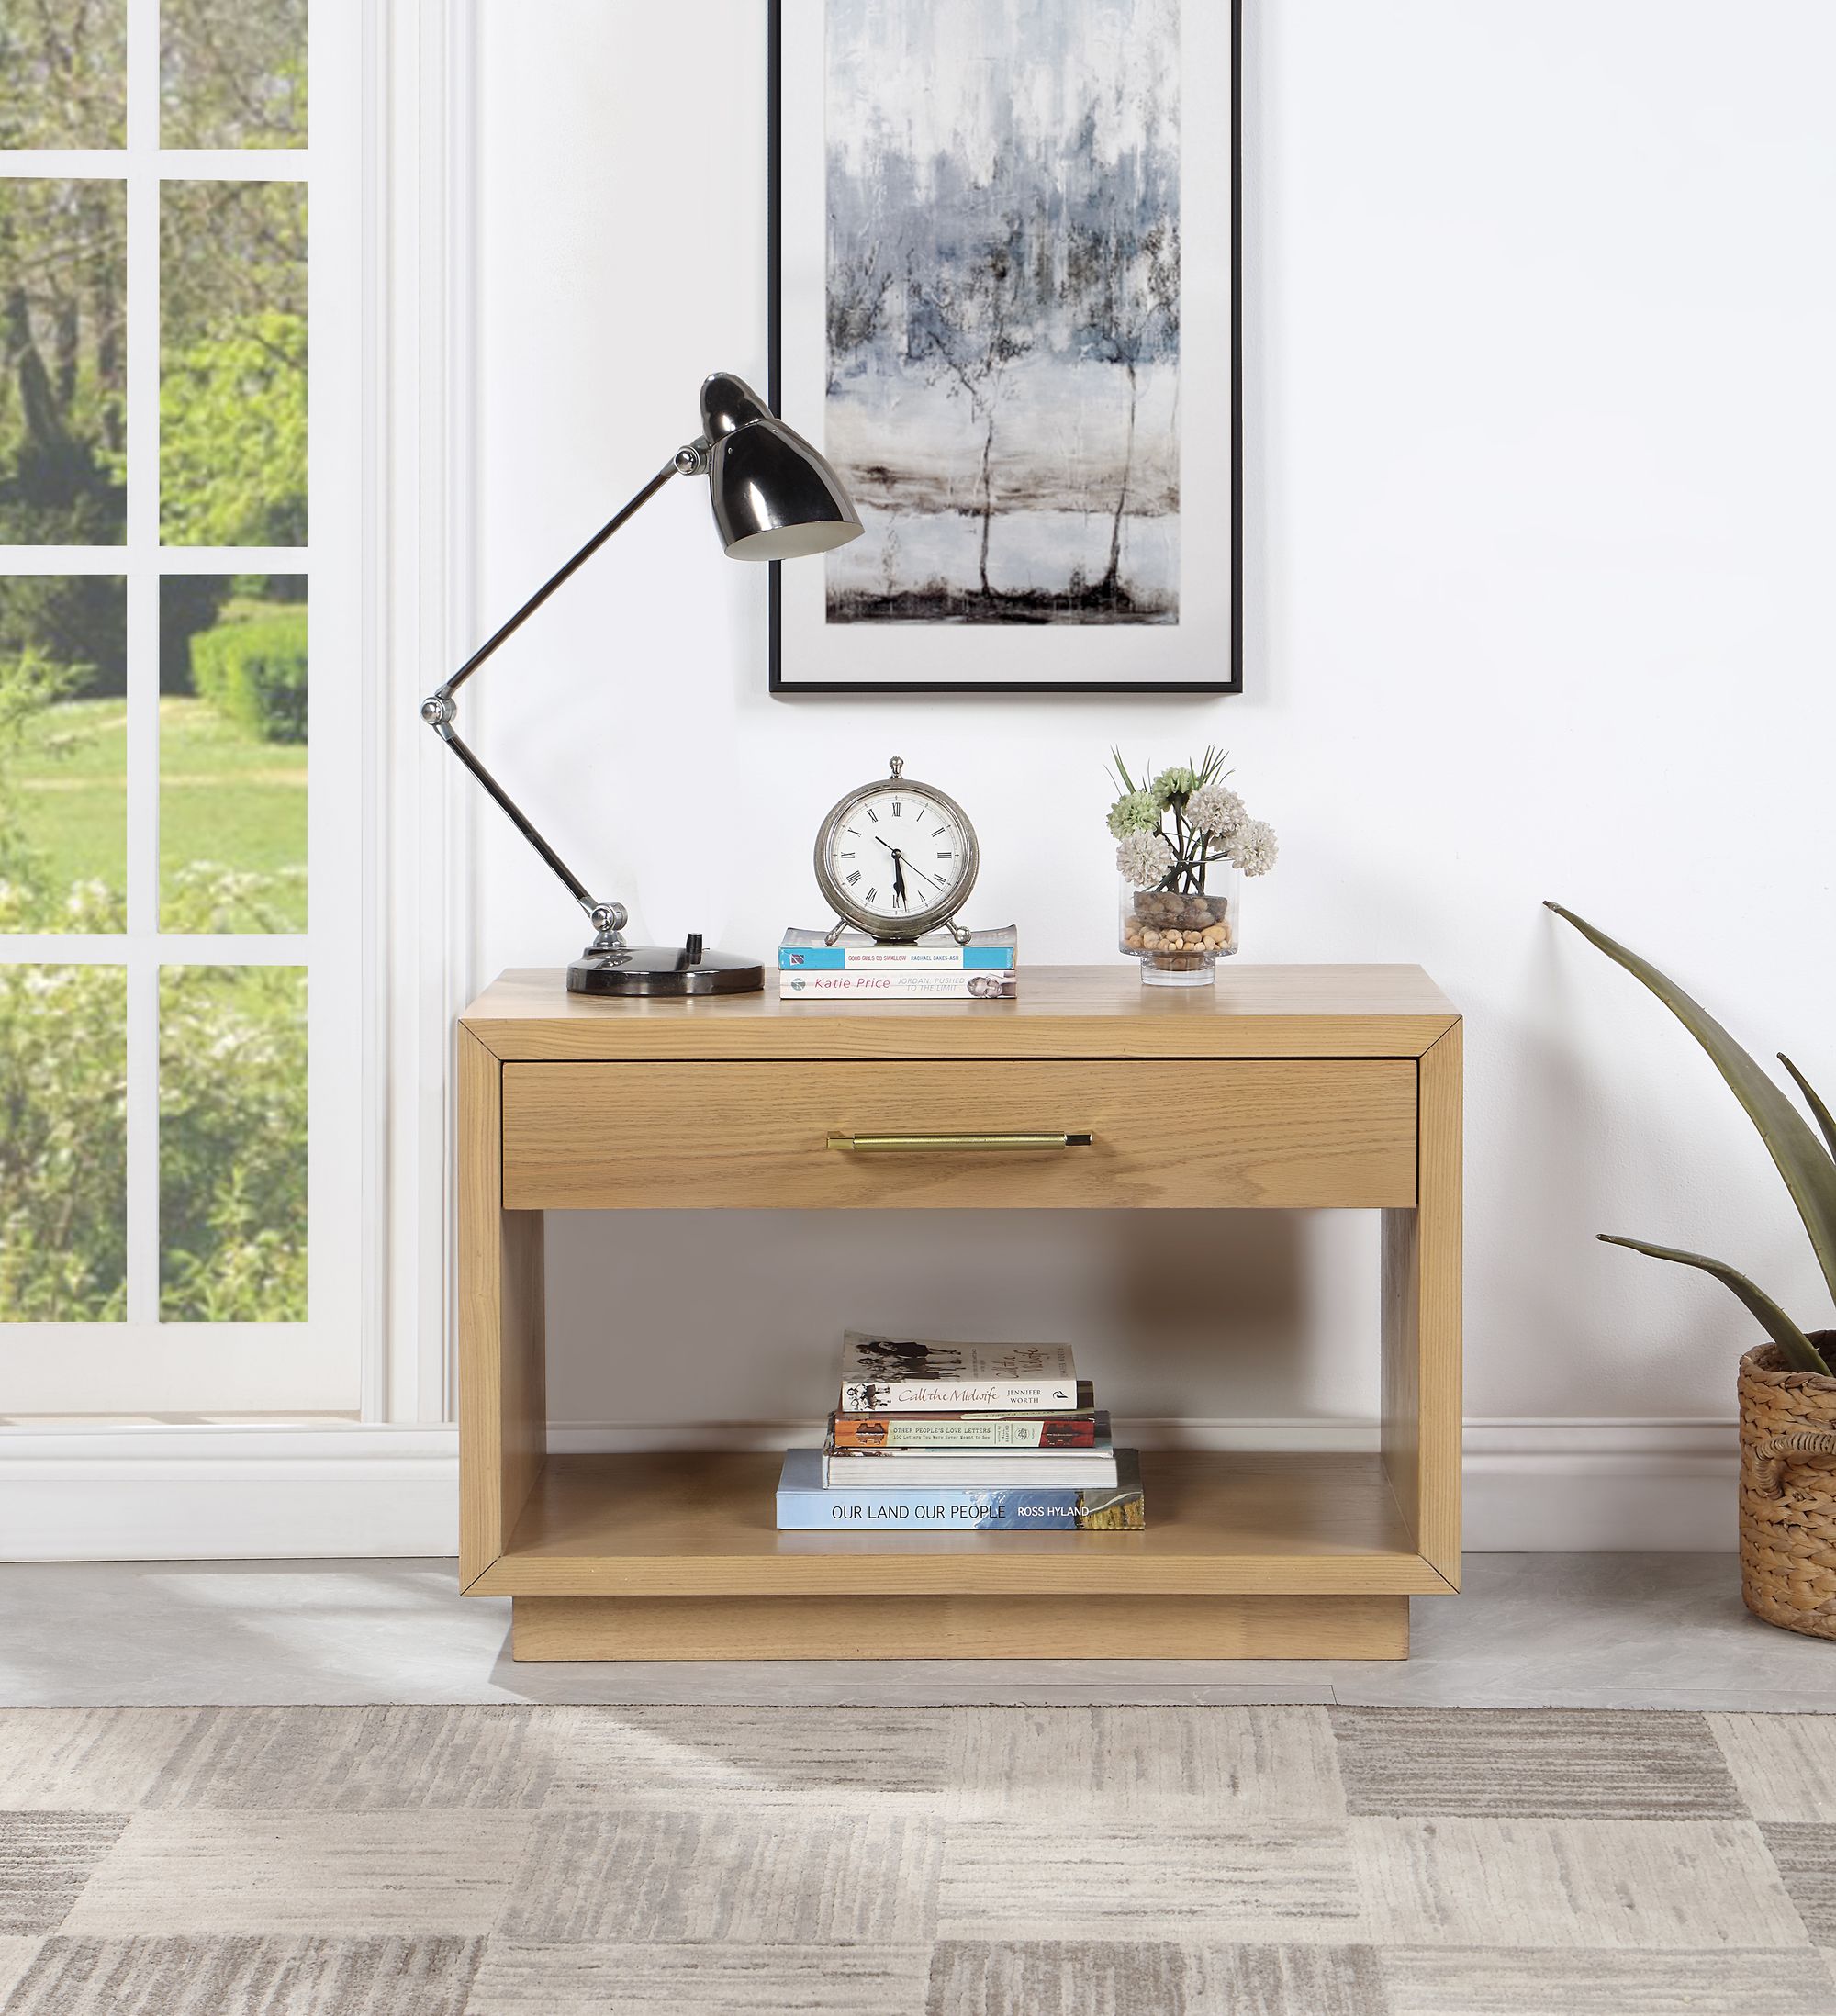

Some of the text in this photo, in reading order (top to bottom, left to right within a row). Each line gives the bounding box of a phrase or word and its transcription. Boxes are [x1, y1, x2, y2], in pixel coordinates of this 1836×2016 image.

[891, 802, 901, 817] XII
[814, 978, 890, 989] Katie Price
[898, 1387, 999, 1404] Call the Midwife
[1007, 1389, 1042, 1397] JENNIFER
[832, 1506, 1090, 1519] OUR LAND OUR PEOPLE ROSS HYLAND
